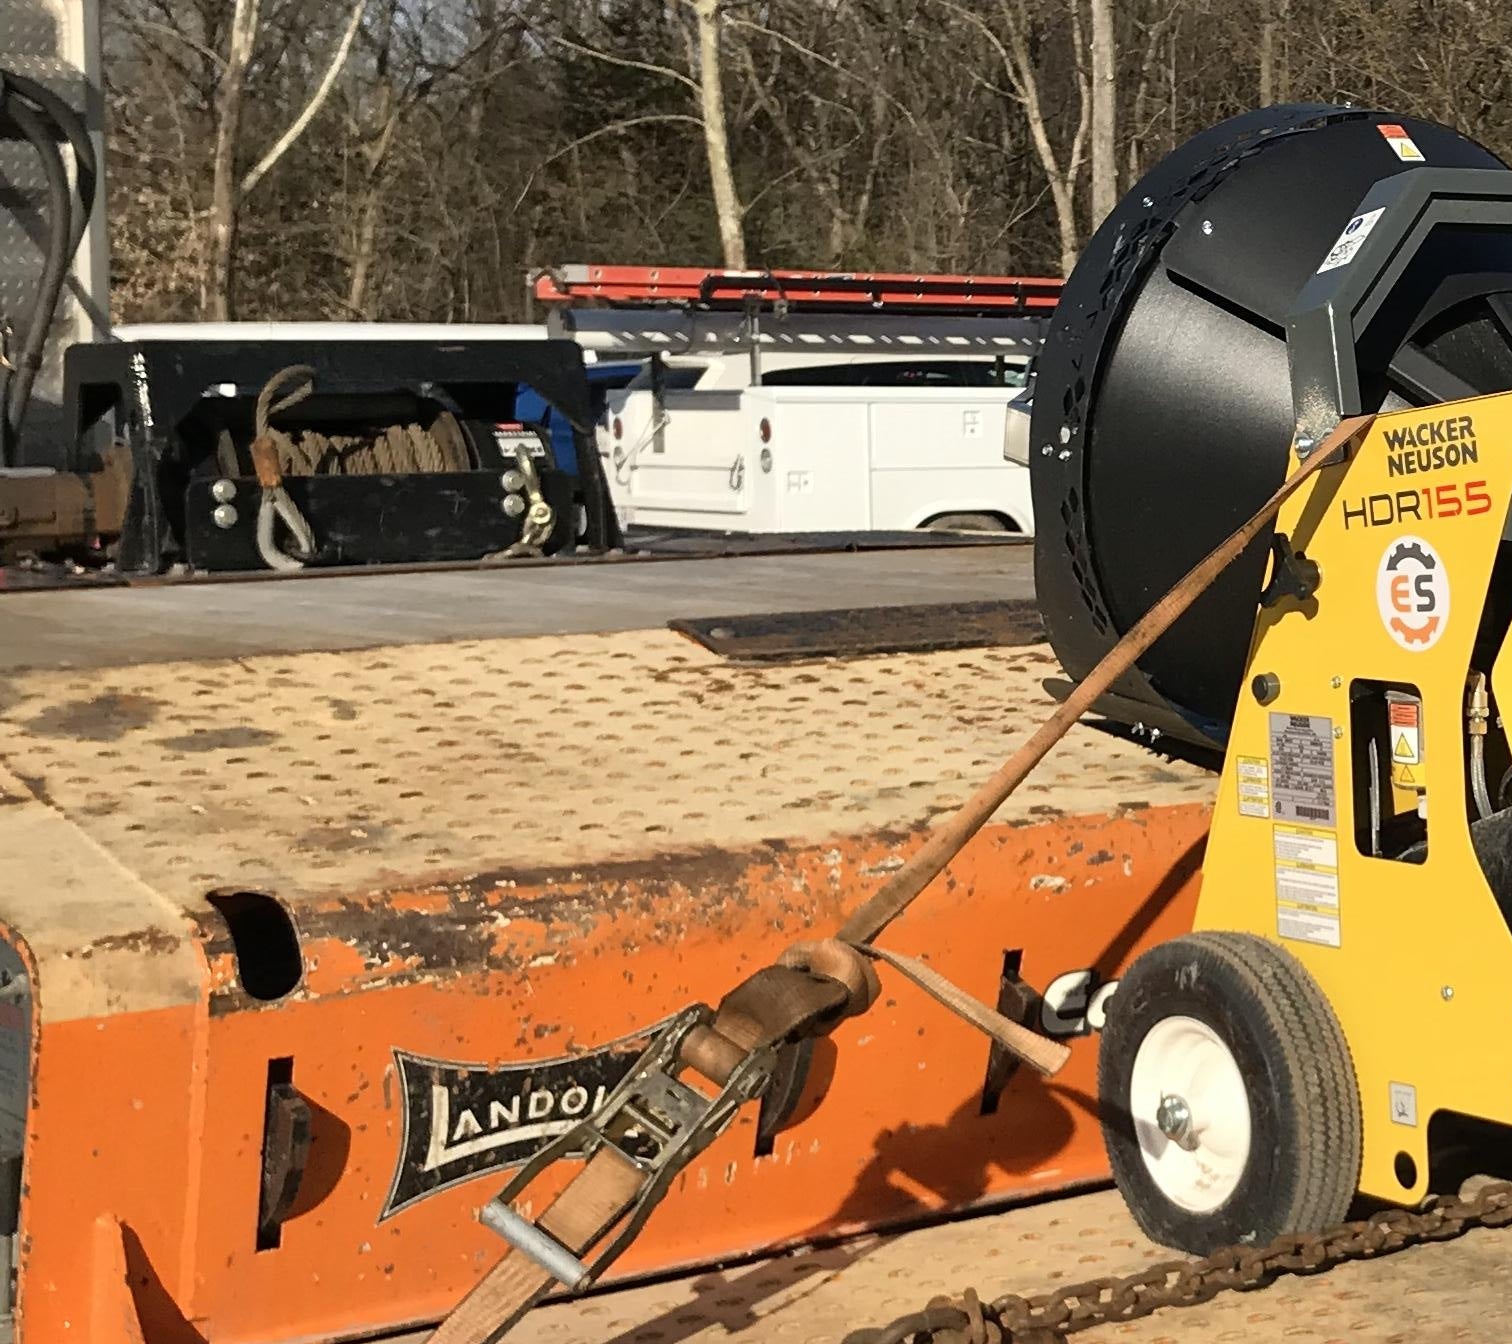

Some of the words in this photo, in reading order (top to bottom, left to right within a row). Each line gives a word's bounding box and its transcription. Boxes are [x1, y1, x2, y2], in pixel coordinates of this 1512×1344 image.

[1383, 415, 1476, 452] WACKER
[1387, 440, 1479, 478] NEUSON
[1342, 480, 1492, 530] HDR155
[1390, 574, 1436, 613] ES
